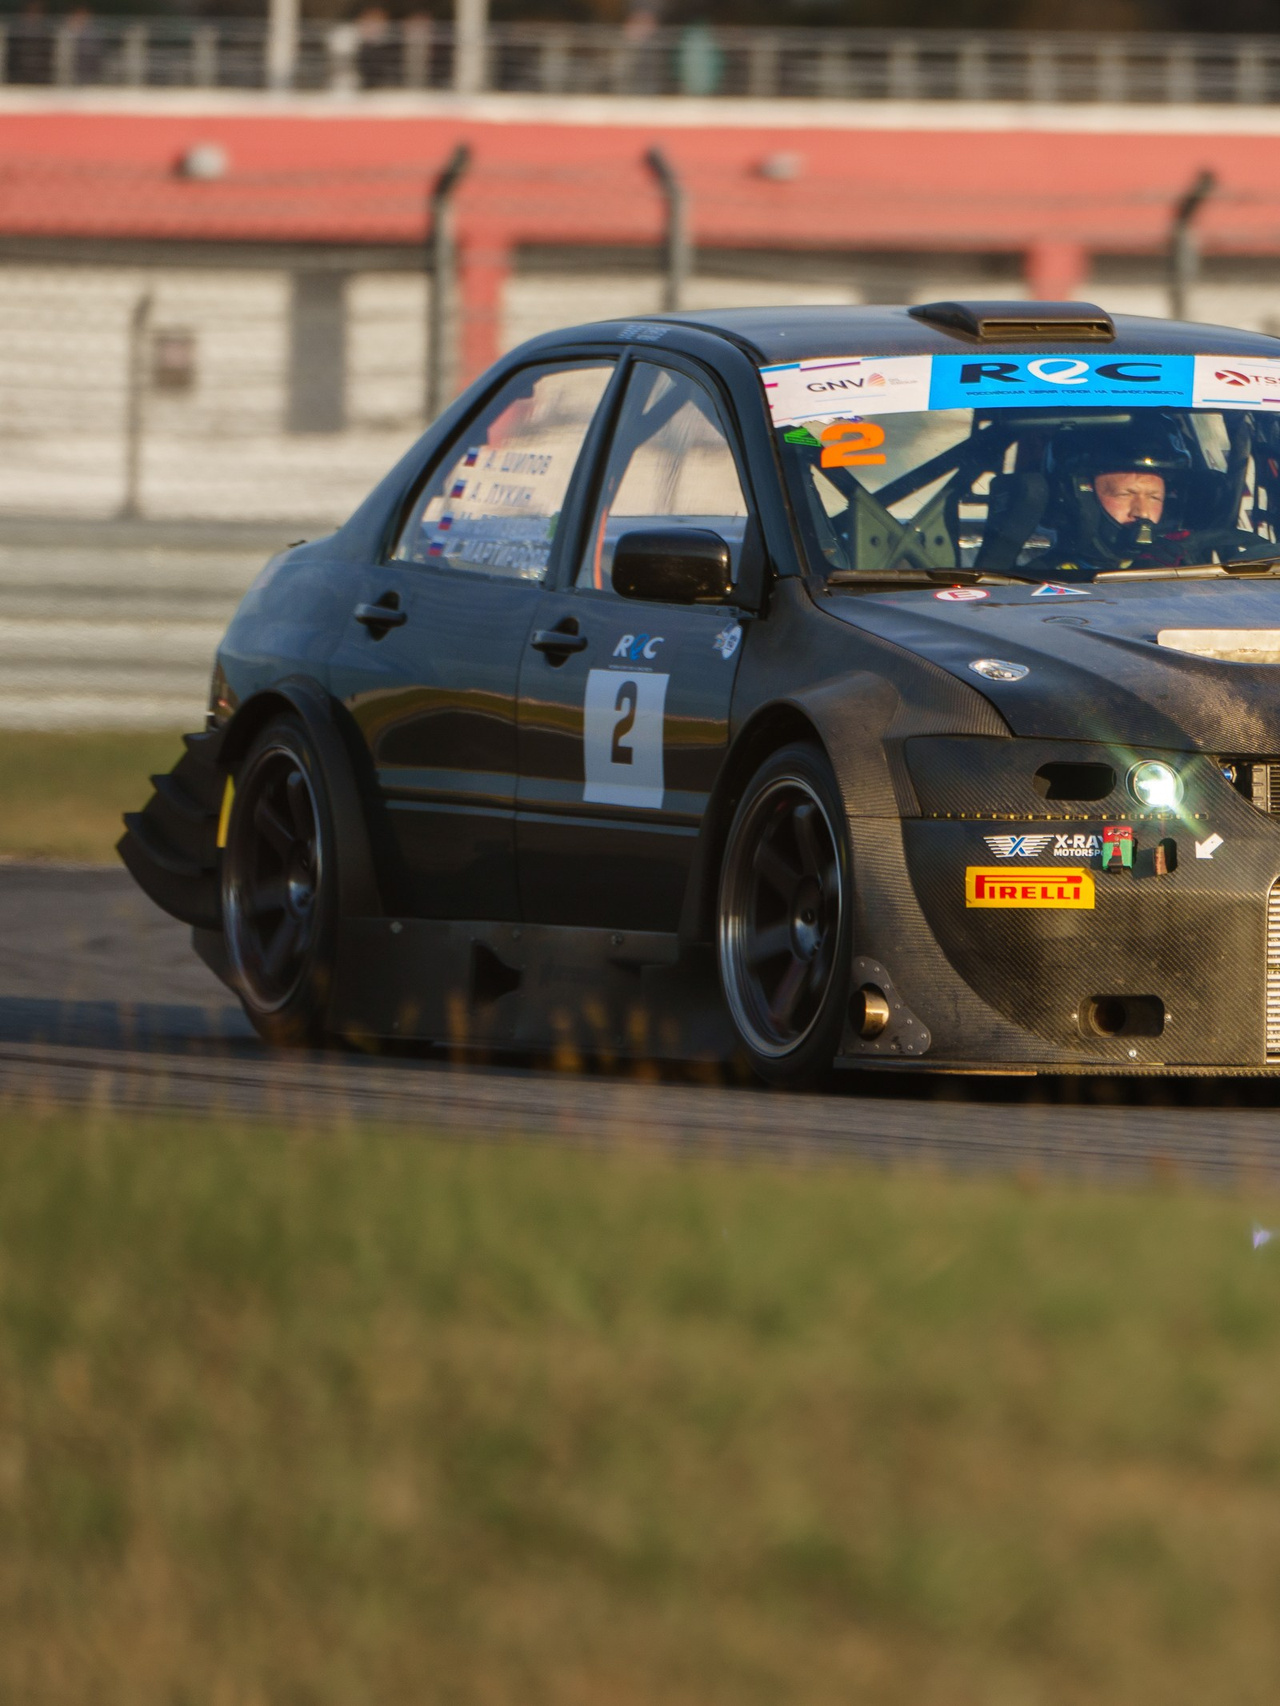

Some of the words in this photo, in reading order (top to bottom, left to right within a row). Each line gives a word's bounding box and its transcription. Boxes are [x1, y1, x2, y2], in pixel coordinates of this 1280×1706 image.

[807, 378, 864, 393] GNV
[820, 423, 887, 469] 2
[611, 681, 638, 765] 2
[1054, 834, 1104, 849] X-RA
[1053, 848, 1104, 857] MOTORSP
[975, 874, 1083, 900] PIRELLI
